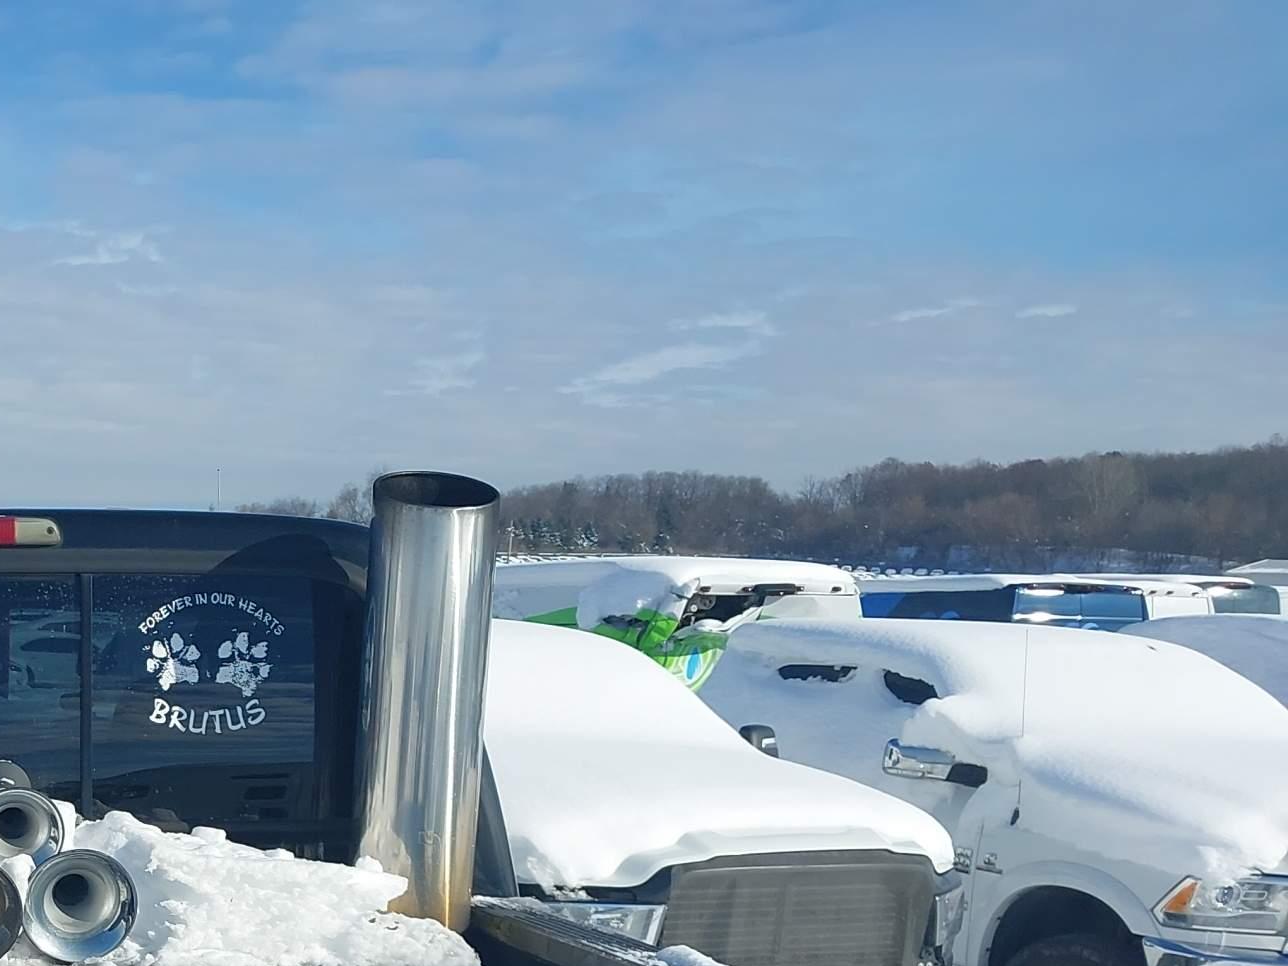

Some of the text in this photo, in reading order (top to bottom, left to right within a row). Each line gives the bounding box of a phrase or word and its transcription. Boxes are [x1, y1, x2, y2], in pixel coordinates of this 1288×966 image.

[138, 592, 285, 636] FOREVER IN OUR HEARTS
[149, 698, 266, 735] BRUTUS
